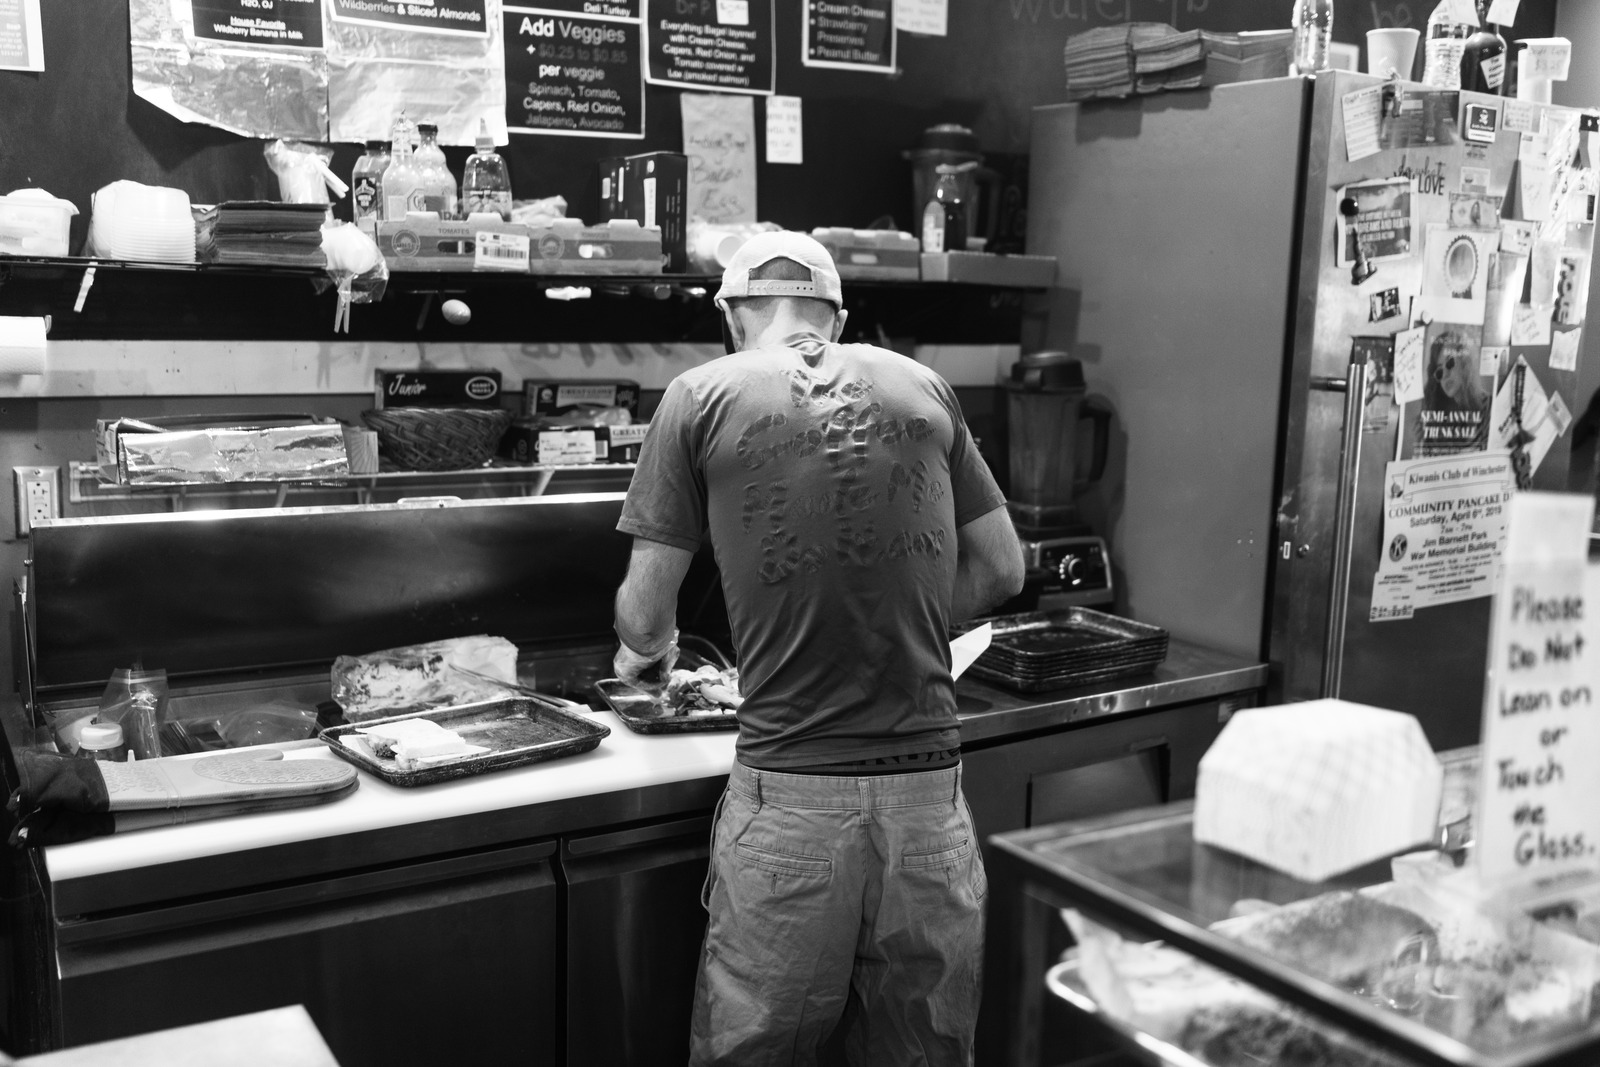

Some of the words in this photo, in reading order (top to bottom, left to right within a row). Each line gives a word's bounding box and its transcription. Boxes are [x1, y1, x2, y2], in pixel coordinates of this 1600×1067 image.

[339, 0, 395, 13] Wildberries
[397, 4, 406, 15] &
[407, 5, 438, 18] Sliced
[439, 8, 481, 22] Almonds
[213, 23, 249, 37] Wildberry
[249, 27, 279, 38] Banana
[280, 30, 287, 38] in
[288, 30, 303, 40] Milk
[519, 16, 555, 37] Add
[558, 20, 626, 45] Veggies
[660, 19, 704, 36] Everything
[688, 34, 714, 46] Cream
[539, 64, 561, 79] per
[563, 65, 605, 82] veggie
[528, 81, 576, 97] Spinach,
[577, 85, 620, 101] Tomato,
[523, 96, 565, 113] Capers,
[567, 99, 589, 113] Red
[591, 101, 626, 117] Onion,
[578, 116, 624, 130] Avocado
[1418, 174, 1446, 196] LOVE
[388, 373, 427, 396] Junior
[1420, 410, 1482, 423] SEMI-ANNUAL
[1424, 426, 1453, 439] TRUNK
[1454, 426, 1477, 439] SALE
[1408, 471, 1440, 485] Kiwanis
[1442, 469, 1462, 480] Club
[1462, 466, 1471, 478] of
[1472, 464, 1507, 477] Winchester
[1388, 501, 1455, 520] COMMUNITY
[1457, 493, 1500, 510] PANCAKE
[1409, 513, 1449, 529] Saturday,
[1451, 510, 1471, 523] April
[1422, 538, 1437, 549] Jim
[1438, 532, 1469, 546] Barnett
[1470, 531, 1488, 542] Park
[1410, 551, 1427, 562] War
[1427, 545, 1467, 559] Memorial
[1467, 541, 1497, 553] Building
[1510, 585, 1584, 624] Please
[1507, 641, 1538, 672] Do
[1543, 631, 1587, 663] Not
[1499, 685, 1553, 718] Lean
[1559, 686, 1593, 708] on
[1539, 725, 1569, 748] or
[1498, 755, 1566, 791] Touch
